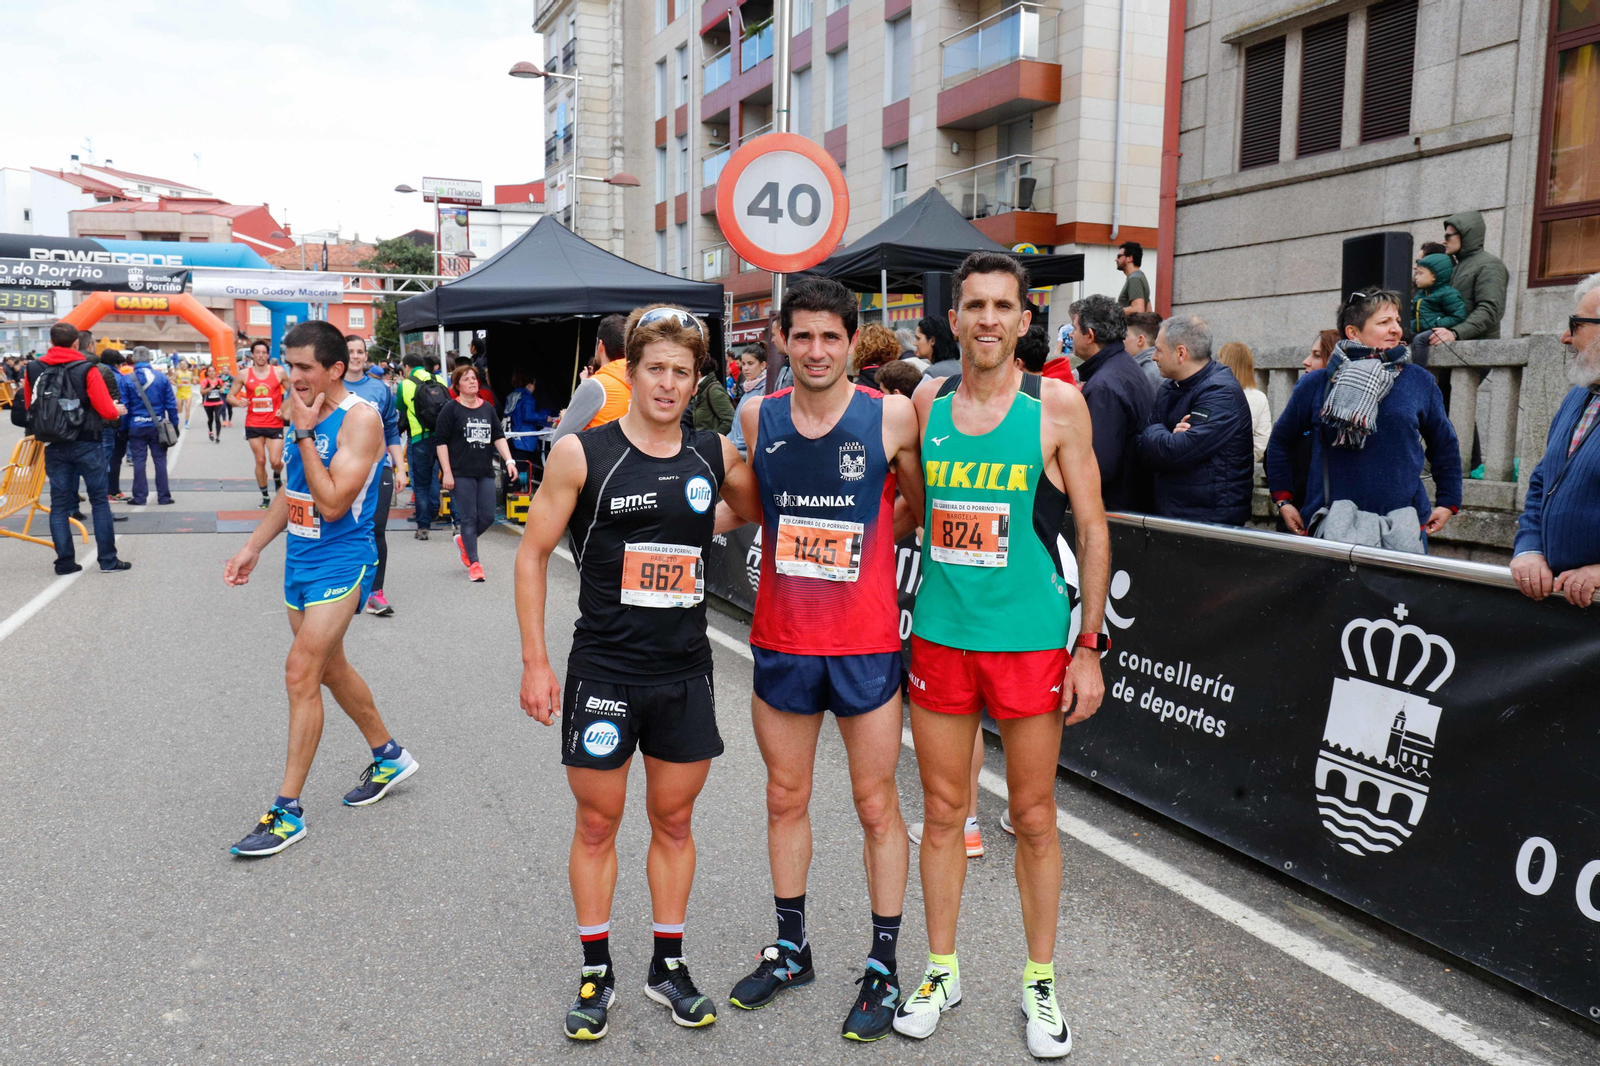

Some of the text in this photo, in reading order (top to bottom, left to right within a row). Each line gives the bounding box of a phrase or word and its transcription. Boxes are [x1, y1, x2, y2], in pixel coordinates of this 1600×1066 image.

[747, 181, 821, 226] 40
[30, 248, 183, 265] POWERADE
[12, 262, 34, 275] do
[38, 264, 103, 278] Porriño
[18, 277, 32, 285] do
[33, 278, 72, 288] Deporte
[146, 282, 182, 292] Porriño
[225, 285, 338, 299] Grupo Godoy Maceira
[115, 296, 169, 310] GADIS
[840, 474, 865, 482] ATLETISMO
[926, 460, 1029, 491] BIKILA
[610, 492, 657, 510] BMC
[610, 505, 652, 515] SWITZERLAND
[942, 520, 983, 550] 824
[794, 535, 837, 565] 1145
[640, 563, 684, 592] 962
[332, 586, 348, 595] asics
[1118, 650, 1235, 703] concellería
[584, 708, 621, 717] SWITZERLAND
[585, 696, 628, 713] BMC
[1111, 676, 1227, 738] de deportes
